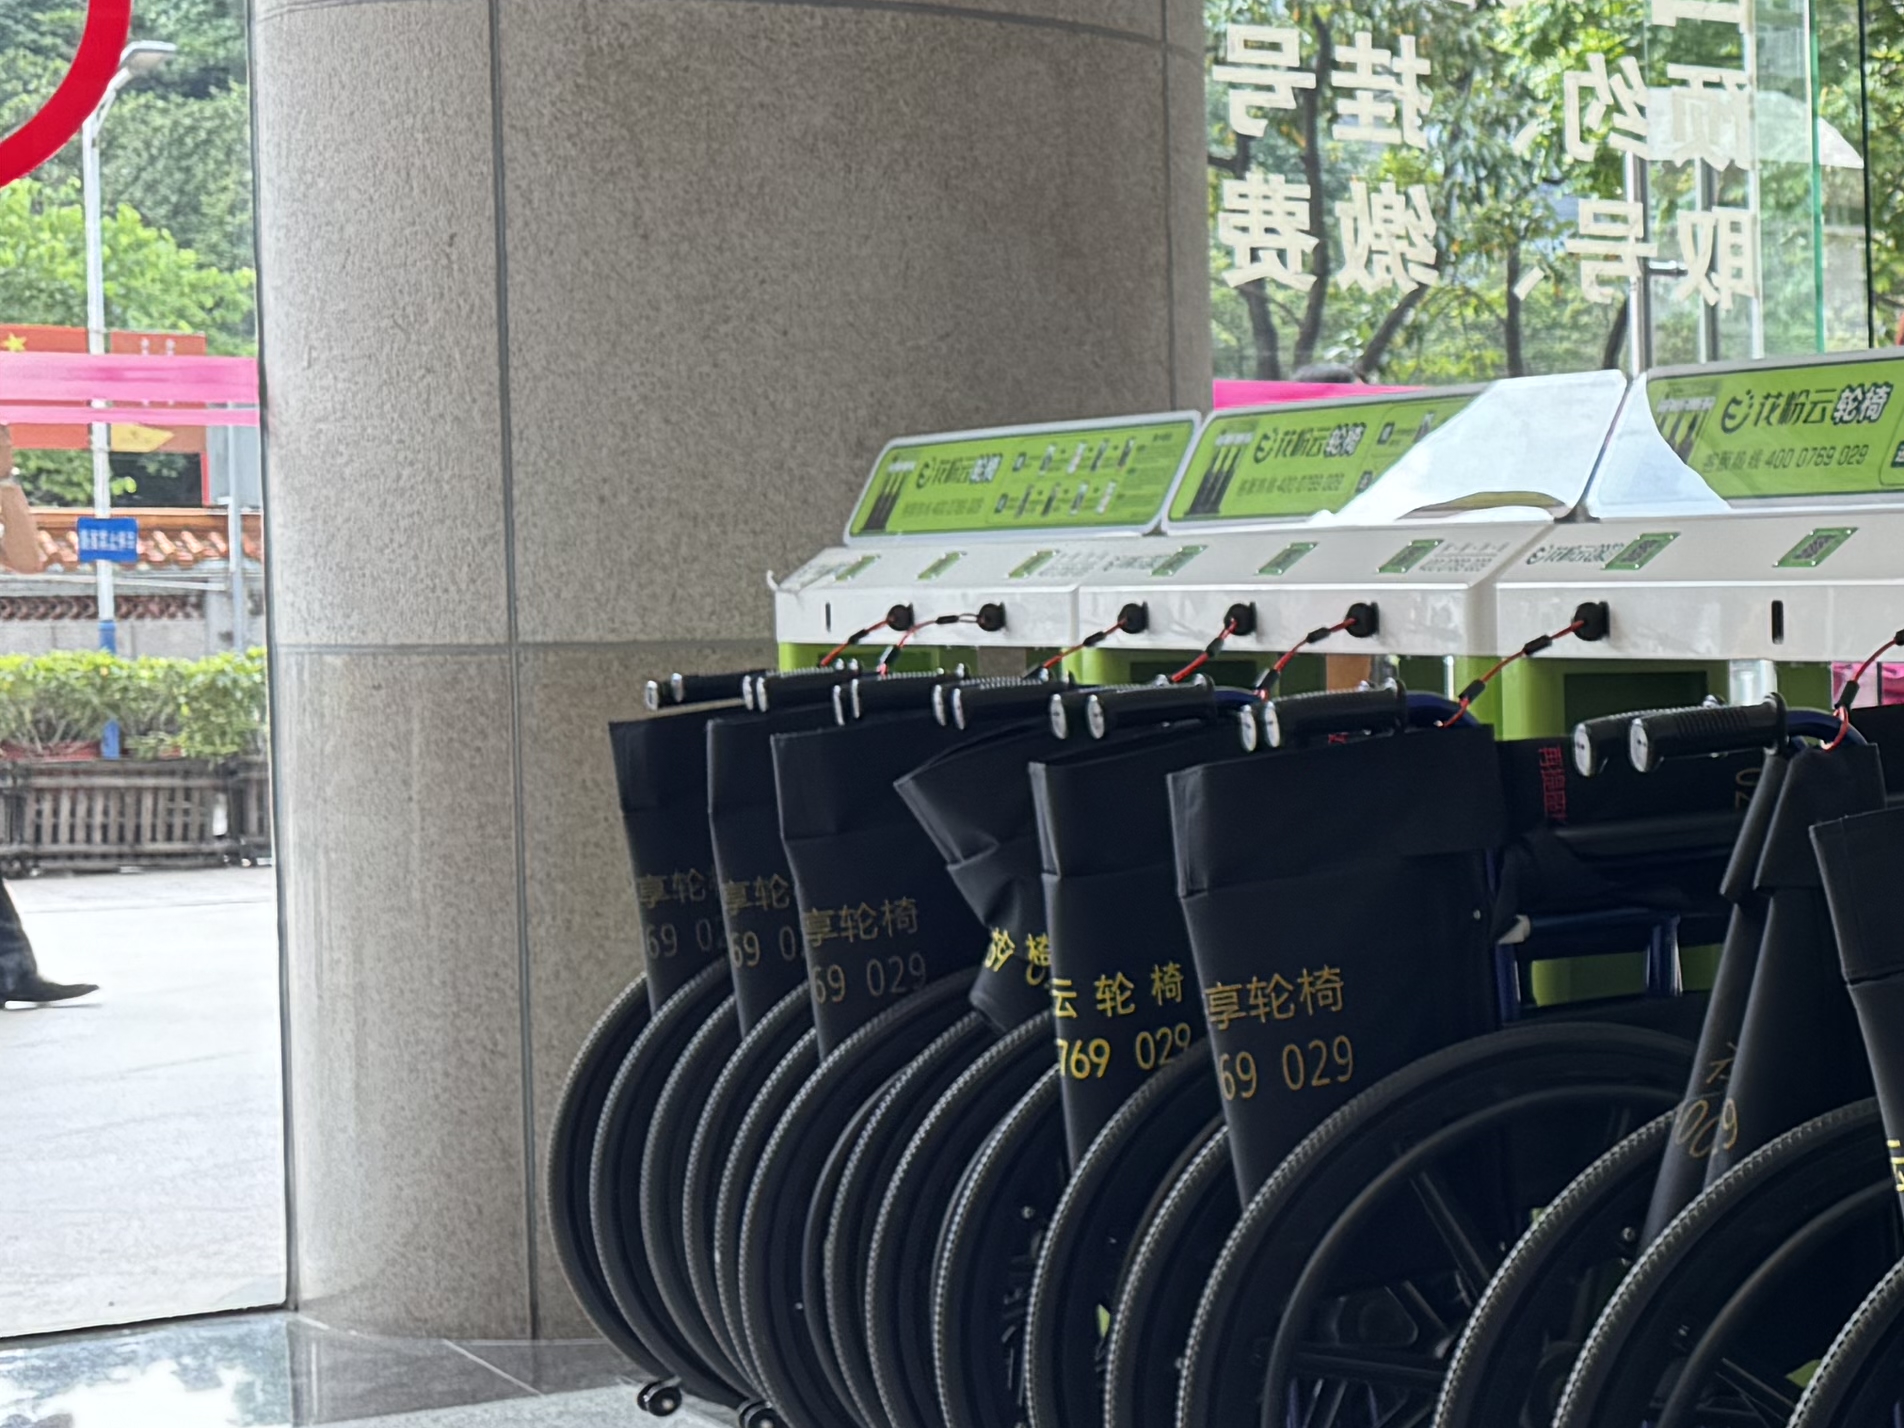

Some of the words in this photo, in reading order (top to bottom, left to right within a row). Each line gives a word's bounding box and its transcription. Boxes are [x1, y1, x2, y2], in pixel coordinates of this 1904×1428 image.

[1753, 381, 1894, 428] 花粉云轮椅
[1765, 447, 1795, 469] 400
[1795, 446, 1837, 468] 0769
[1837, 444, 1870, 466] 029
[637, 867, 712, 908] 享轮
[866, 951, 926, 998] 029
[1204, 964, 1344, 1031] 享轮椅
[1218, 1051, 1257, 1101] 69
[1282, 1035, 1353, 1091] 029
